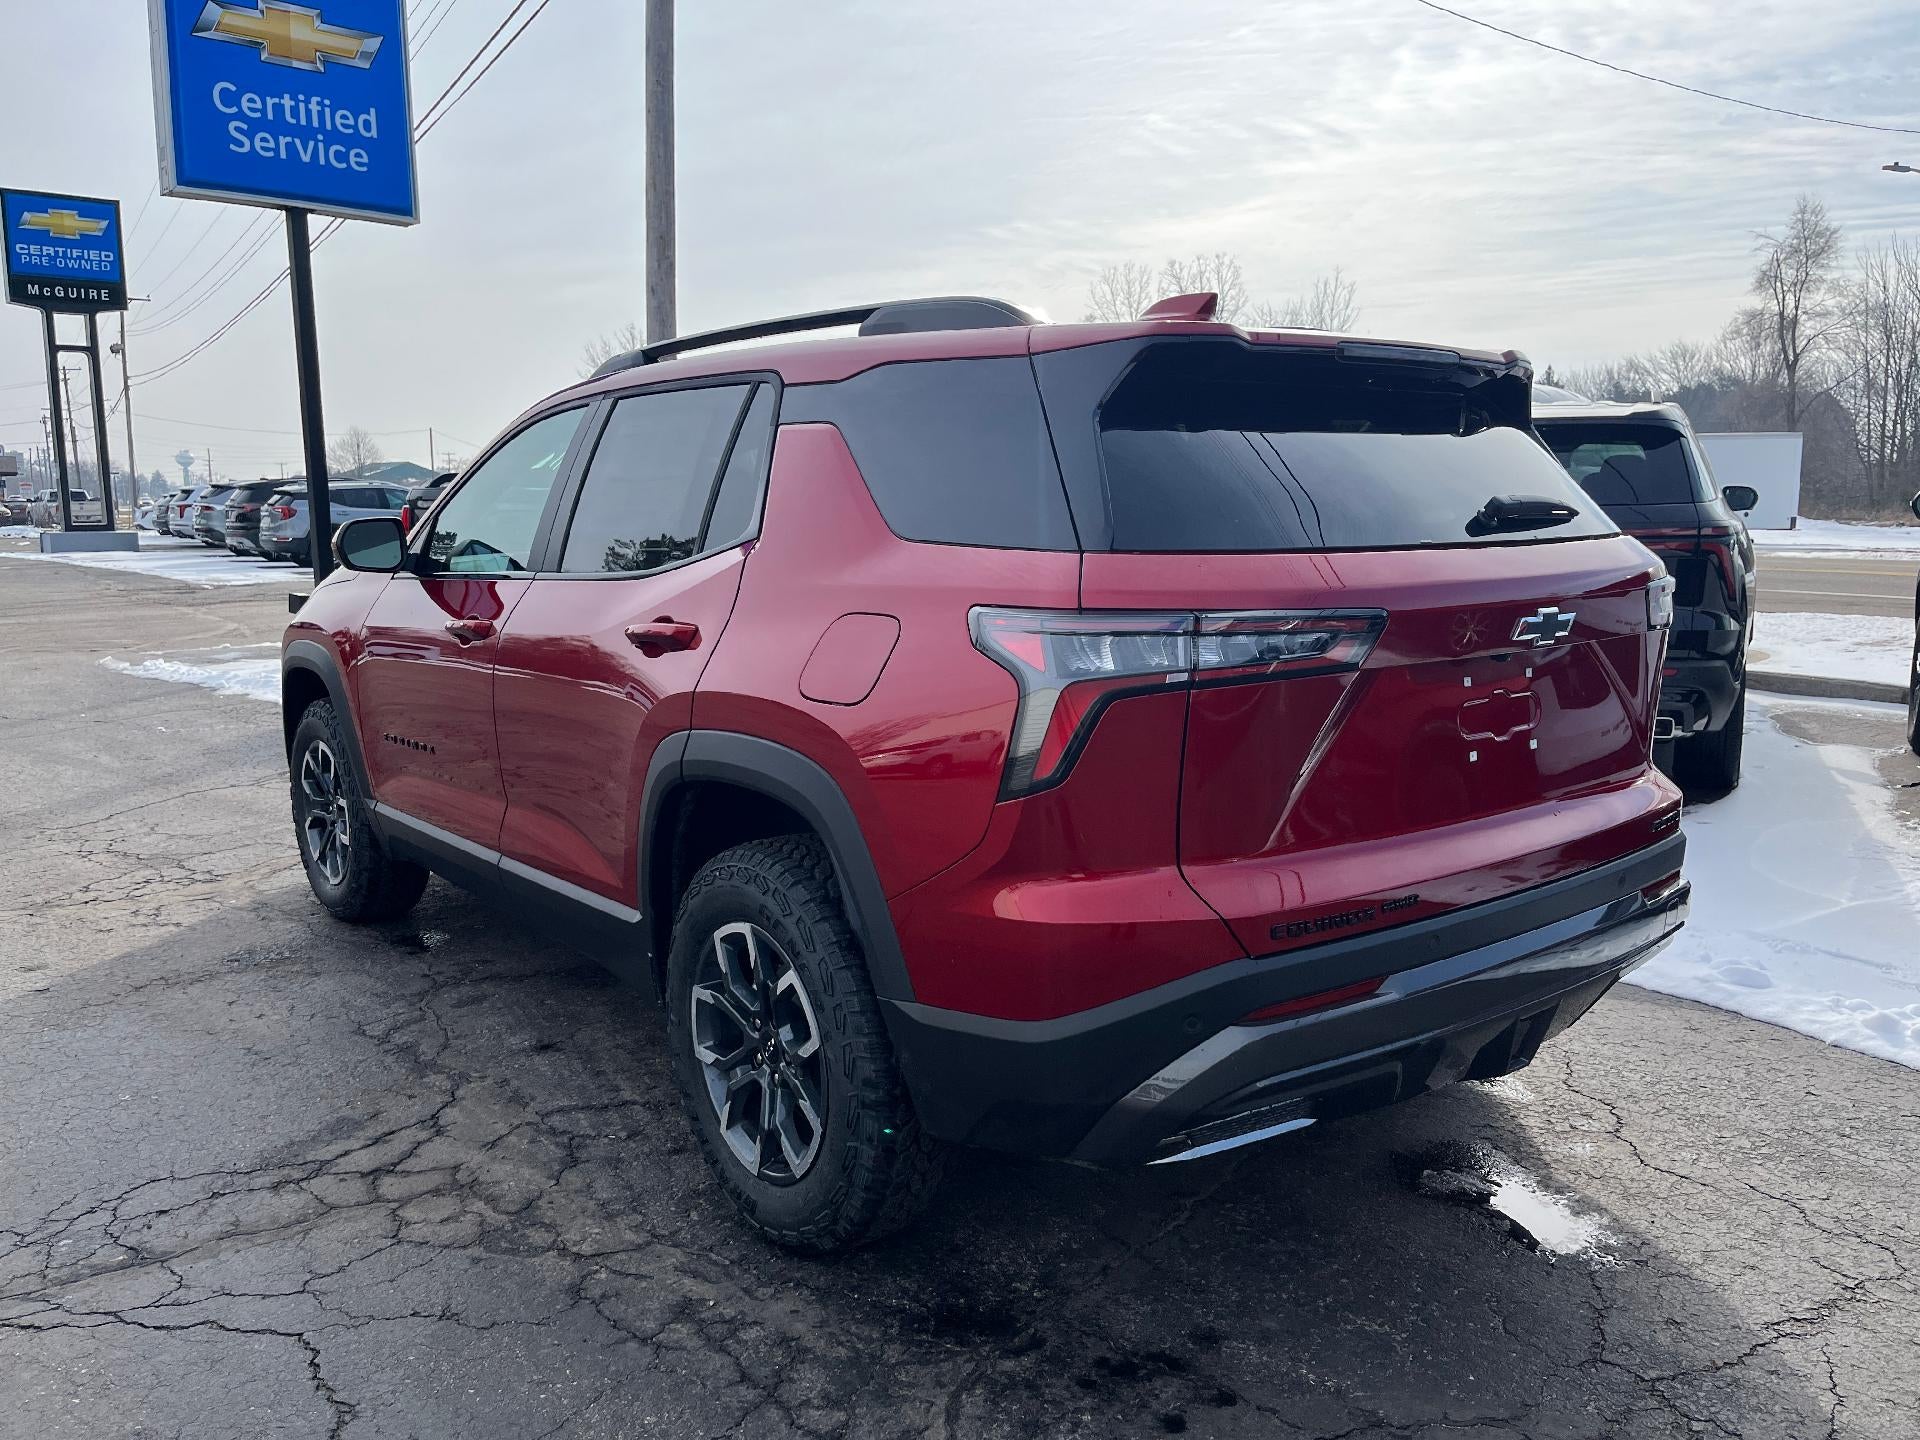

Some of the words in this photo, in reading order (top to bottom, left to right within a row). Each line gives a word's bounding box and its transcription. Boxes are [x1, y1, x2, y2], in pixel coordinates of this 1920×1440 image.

[212, 81, 378, 139] Certified
[227, 120, 369, 172] Service
[15, 243, 114, 261] CERTIFIED
[21, 254, 111, 271] PRE-OWNED
[27, 283, 110, 301] McGUIRE
